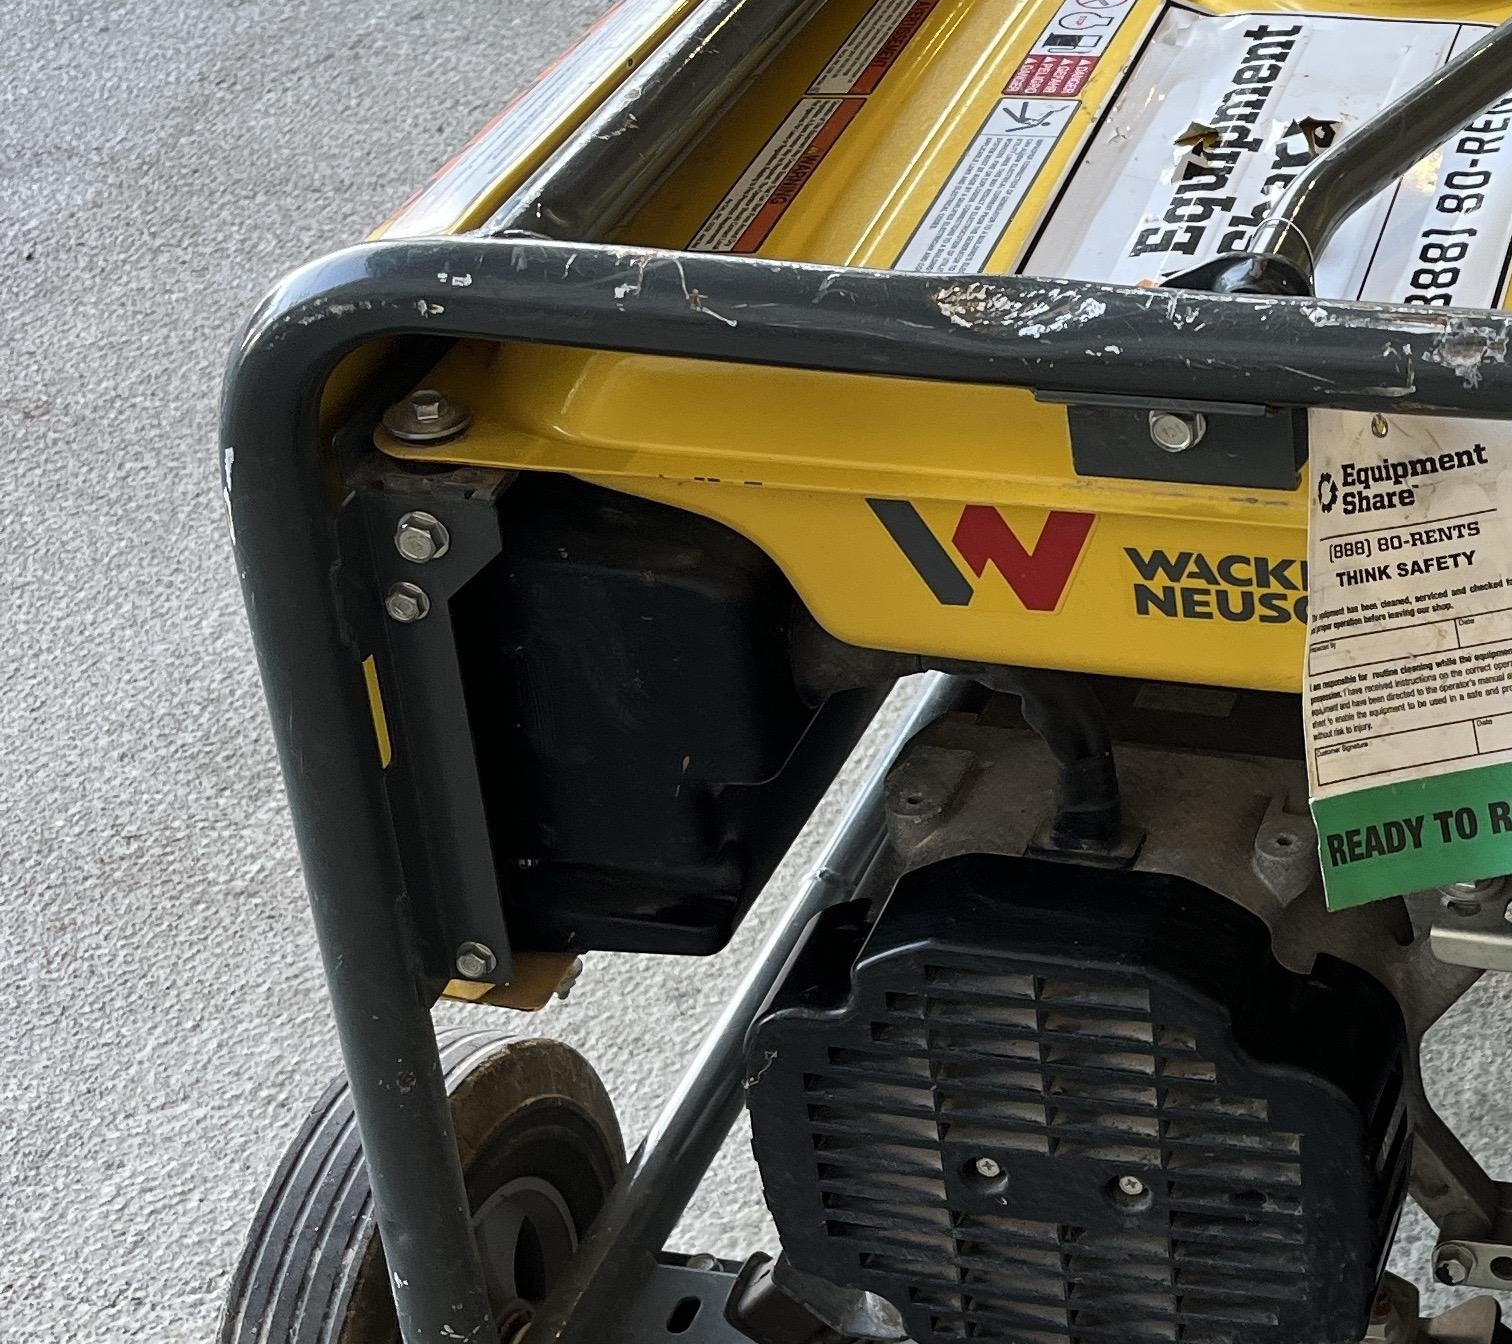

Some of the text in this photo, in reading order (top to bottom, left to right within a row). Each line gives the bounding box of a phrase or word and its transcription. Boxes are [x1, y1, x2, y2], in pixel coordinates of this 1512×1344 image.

[1341, 443, 1489, 490] Equipment
[1342, 488, 1416, 516] Share
[1329, 521, 1481, 563] (888) 80-RENTS
[1123, 546, 1308, 591] WACK
[1336, 550, 1477, 588] THINK SAFETY
[1365, 681, 1393, 692] received
[1395, 675, 1436, 687] instructions
[1465, 664, 1491, 675] correct
[1459, 655, 1472, 664] the
[1386, 689, 1415, 701] directed
[1327, 815, 1425, 867] READY
[1433, 807, 1478, 843] TO
